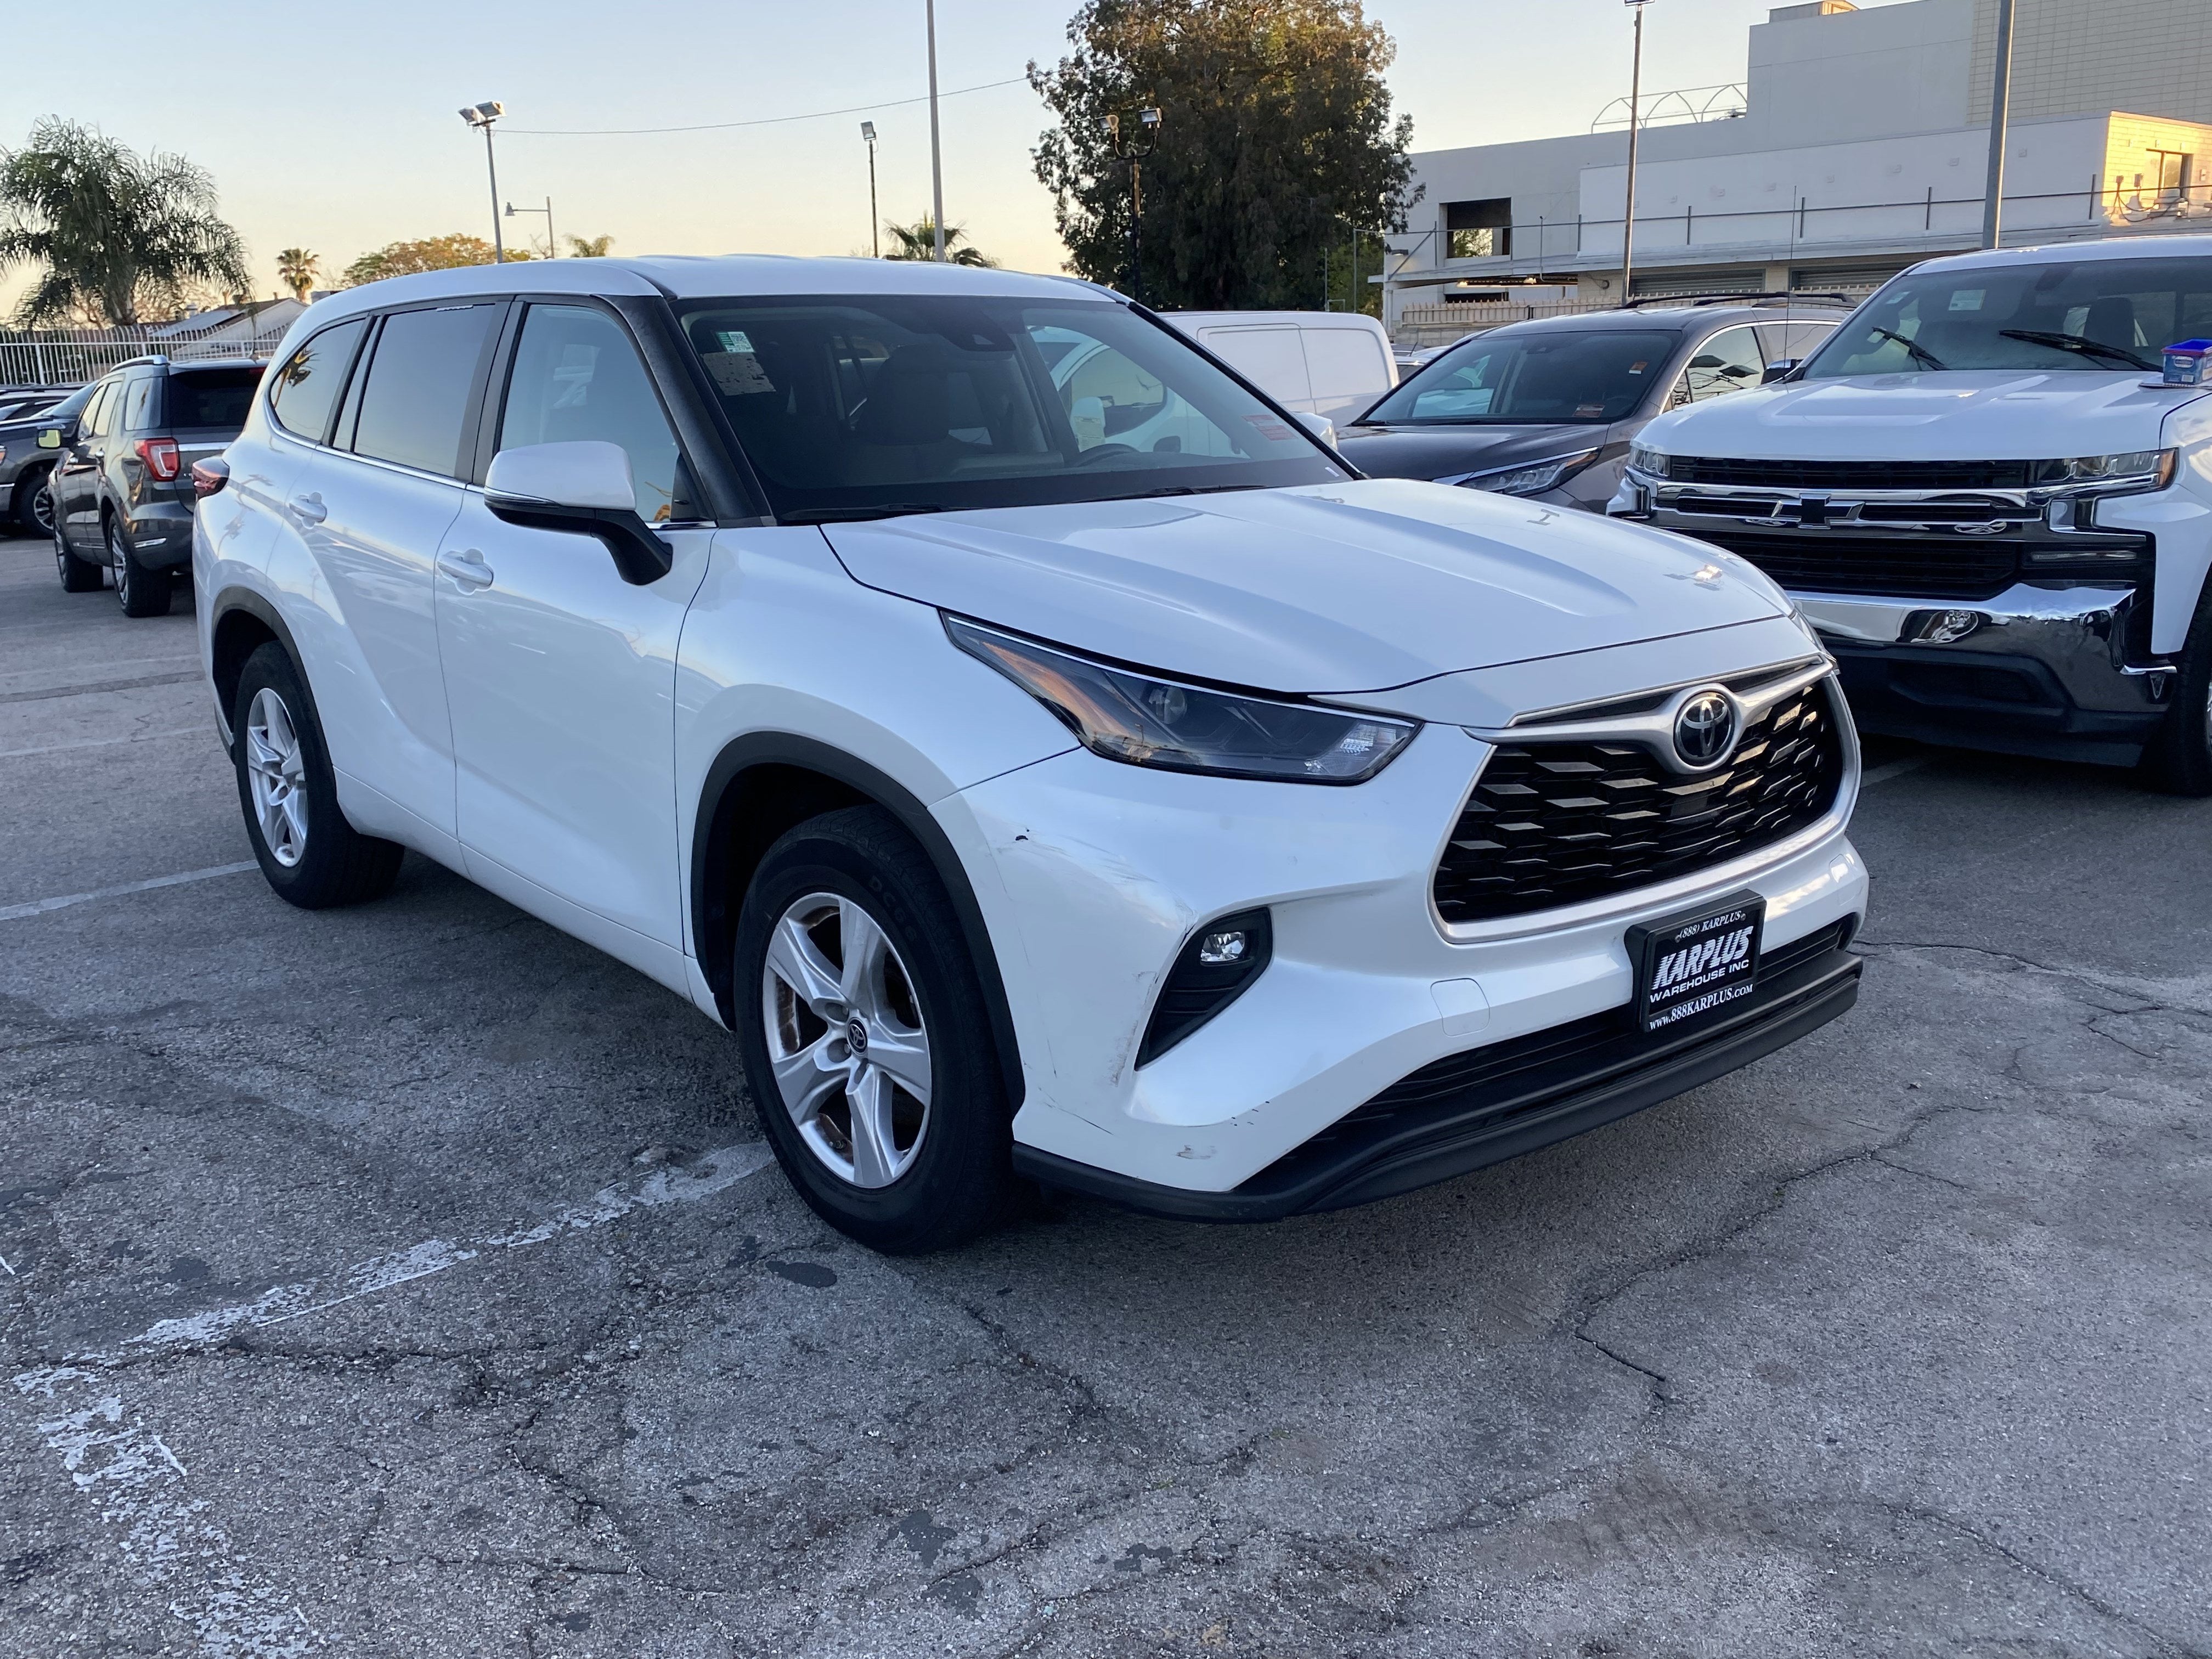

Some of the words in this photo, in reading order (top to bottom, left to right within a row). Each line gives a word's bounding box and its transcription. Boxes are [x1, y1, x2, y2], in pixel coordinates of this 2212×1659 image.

[1680, 924, 1700, 939] (888)
[1701, 911, 1742, 932] KARPLUS
[1651, 926, 1754, 990] KARPLUS
[1650, 967, 1726, 1003] WAREHOUSE
[1729, 959, 1749, 973] INC
